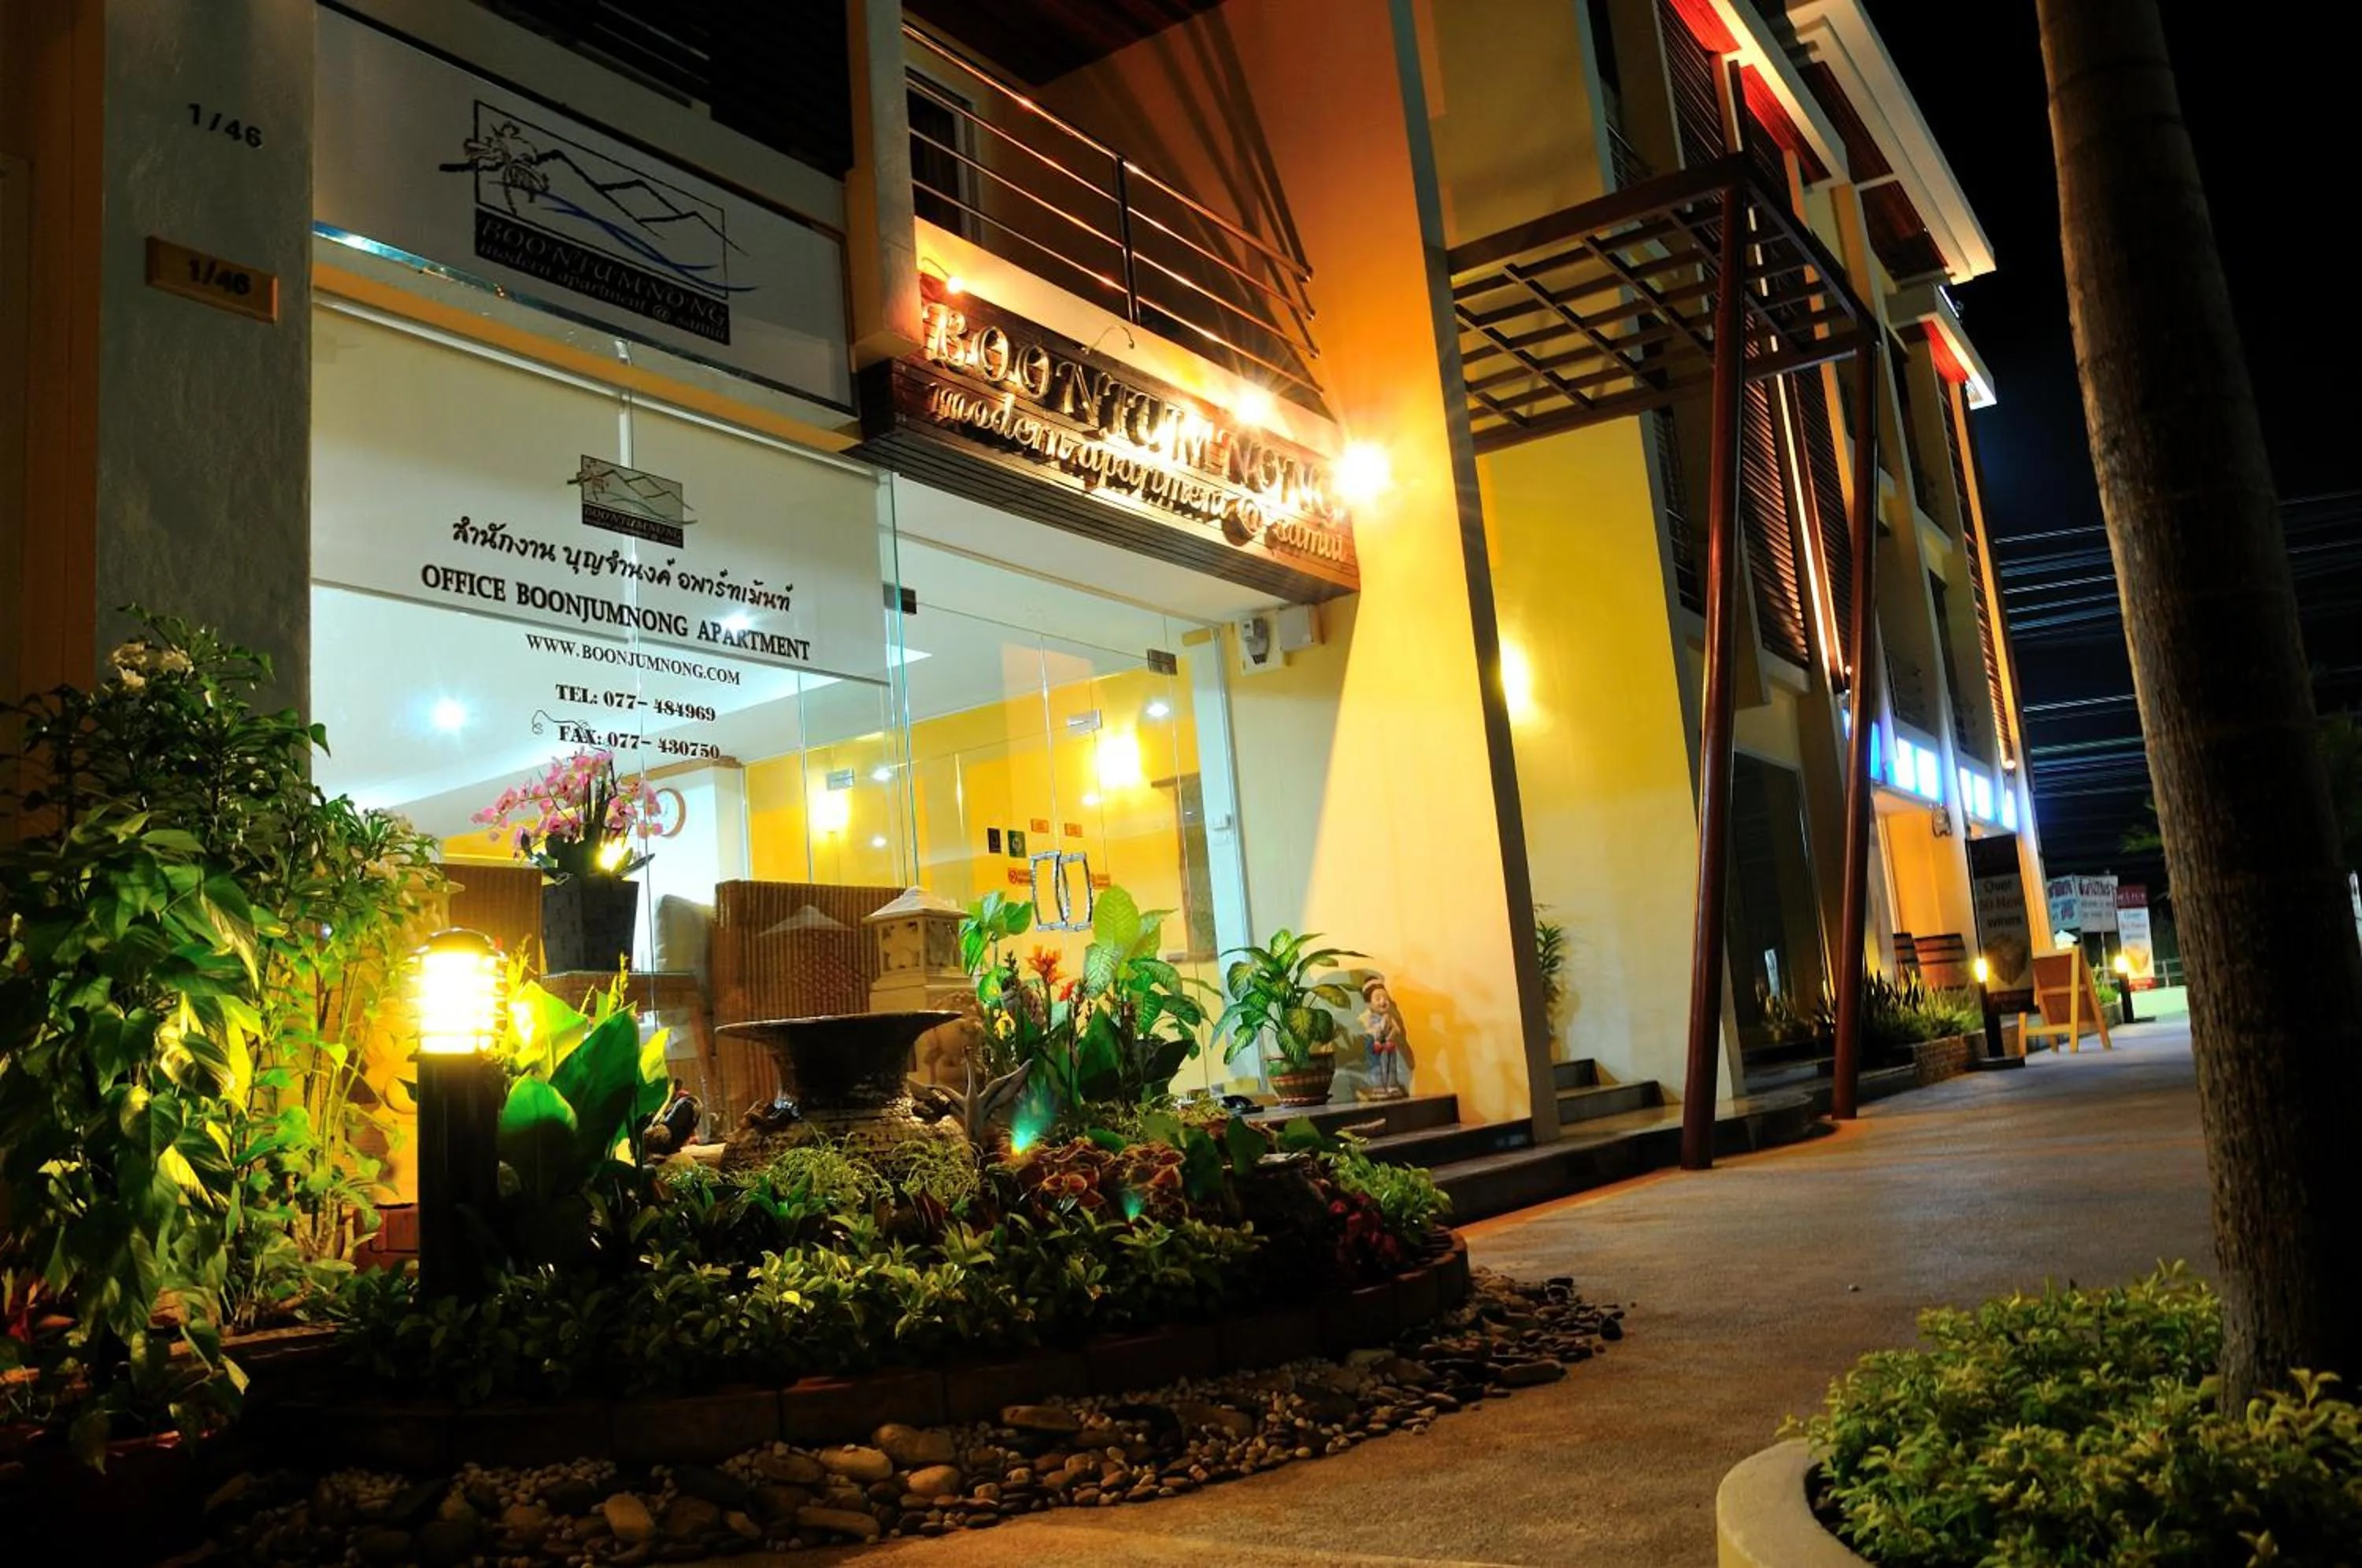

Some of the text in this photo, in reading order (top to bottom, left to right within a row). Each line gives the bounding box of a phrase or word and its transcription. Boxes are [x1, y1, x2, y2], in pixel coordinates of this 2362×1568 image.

[188, 103, 262, 148] 1/46
[189, 258, 251, 296] 1/46
[479, 239, 552, 276] modern
[556, 270, 646, 312] apartment
[924, 382, 1072, 460] modern
[1075, 441, 1225, 517] apartment
[1272, 519, 1346, 562] samui
[453, 516, 557, 561] สำนักงาน
[421, 564, 811, 660] OFFICE BOONJUMNONG APARTMENT
[526, 634, 741, 685] WWW.BOONJUMNONG.COM
[555, 684, 598, 705] TEL:
[558, 725, 602, 745] FAX:
